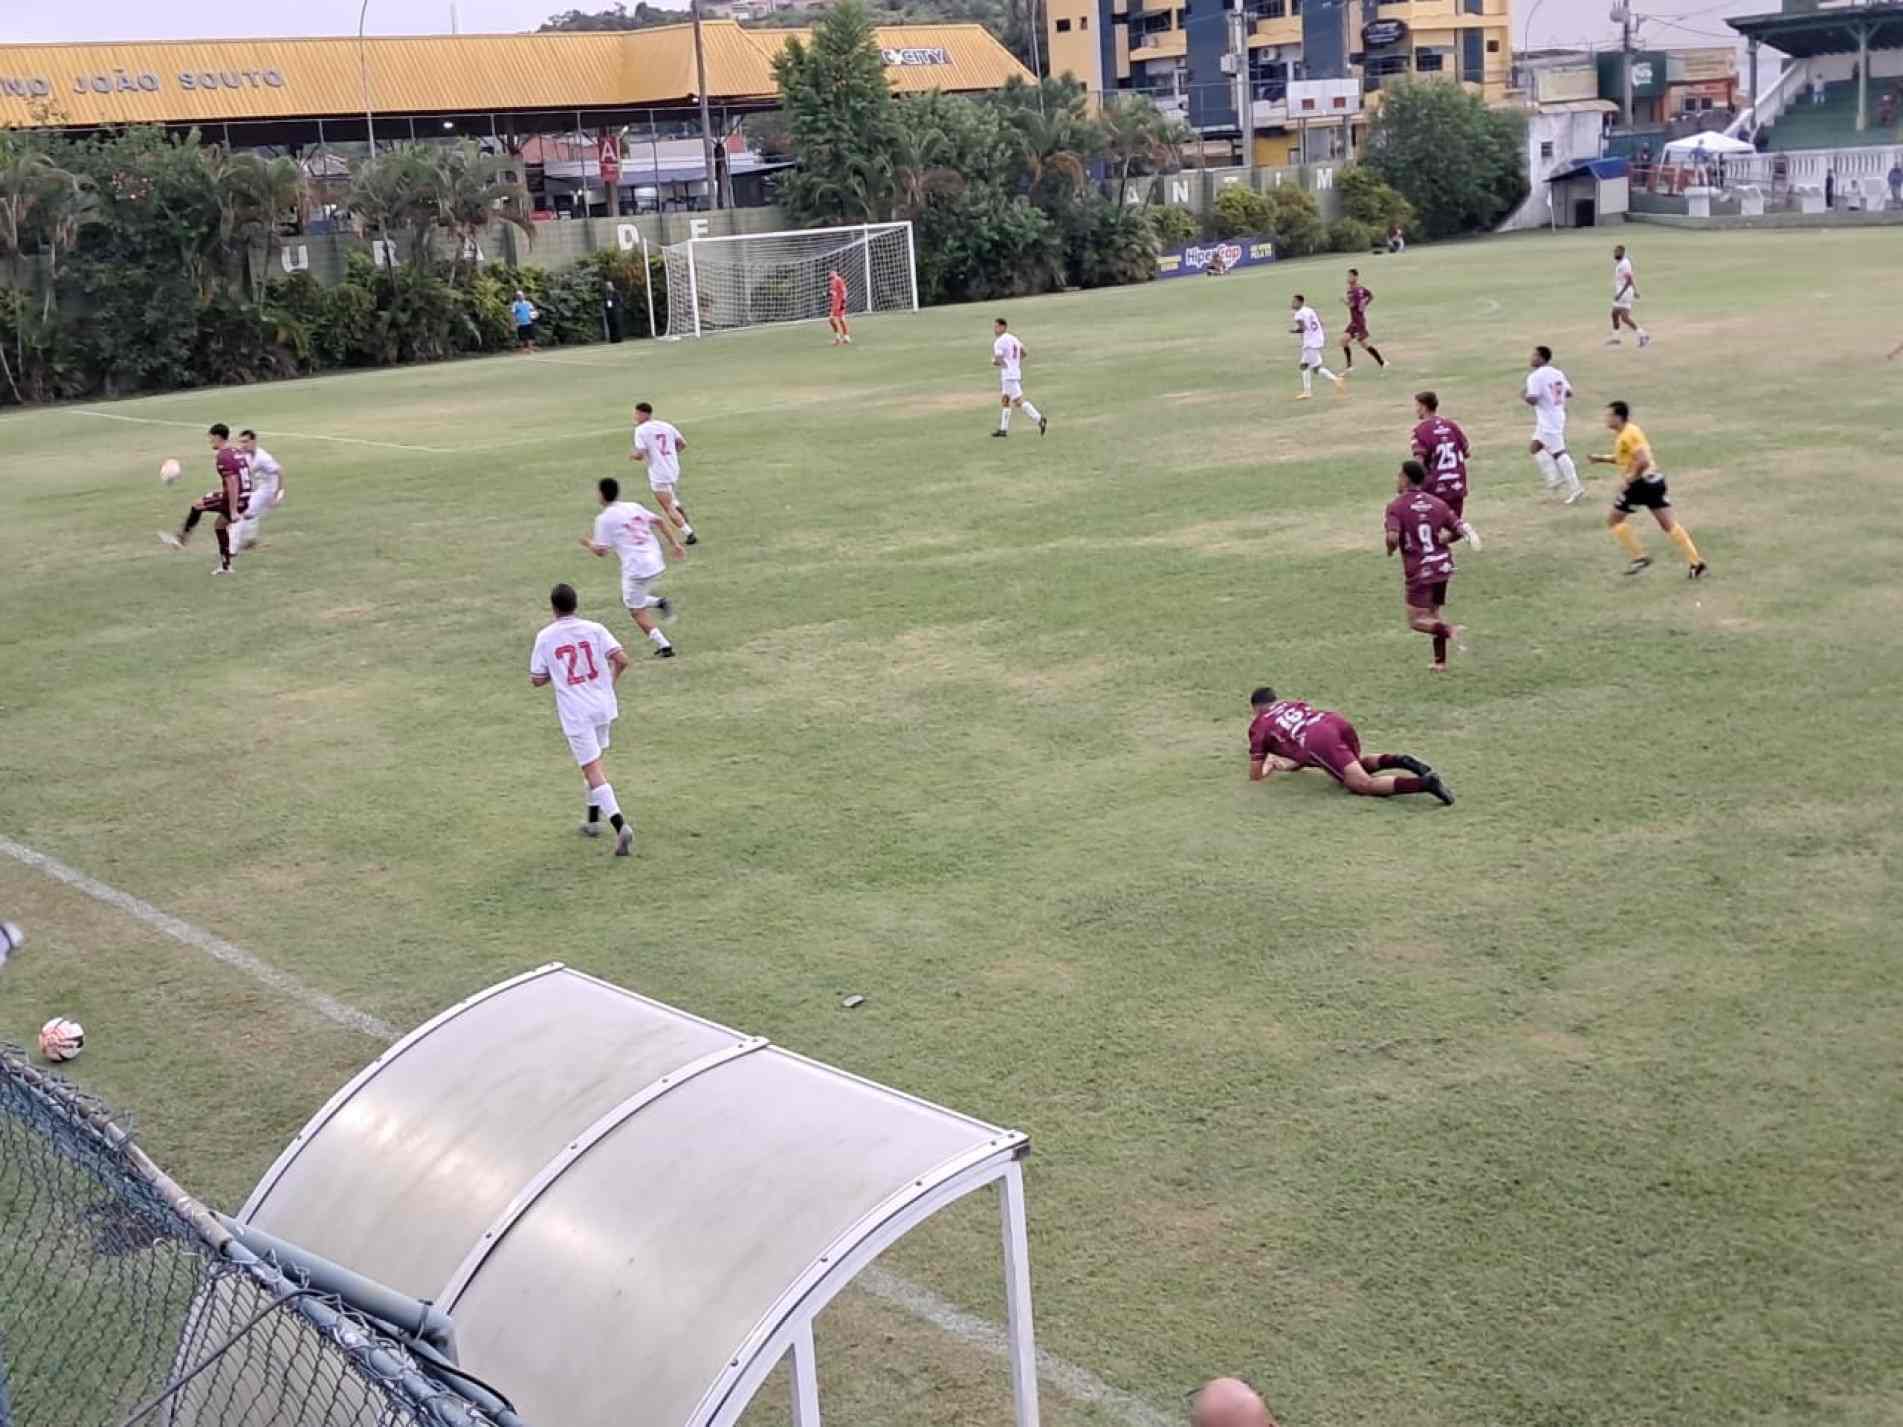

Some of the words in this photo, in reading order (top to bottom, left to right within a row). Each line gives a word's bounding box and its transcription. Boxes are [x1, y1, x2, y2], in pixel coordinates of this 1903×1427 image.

[74, 68, 160, 94] JOÃO
[177, 69, 284, 89] SOUTO
[656, 433, 671, 456] 2
[1435, 442, 1457, 471] 25
[1418, 523, 1434, 553] 9
[555, 640, 600, 685] 21
